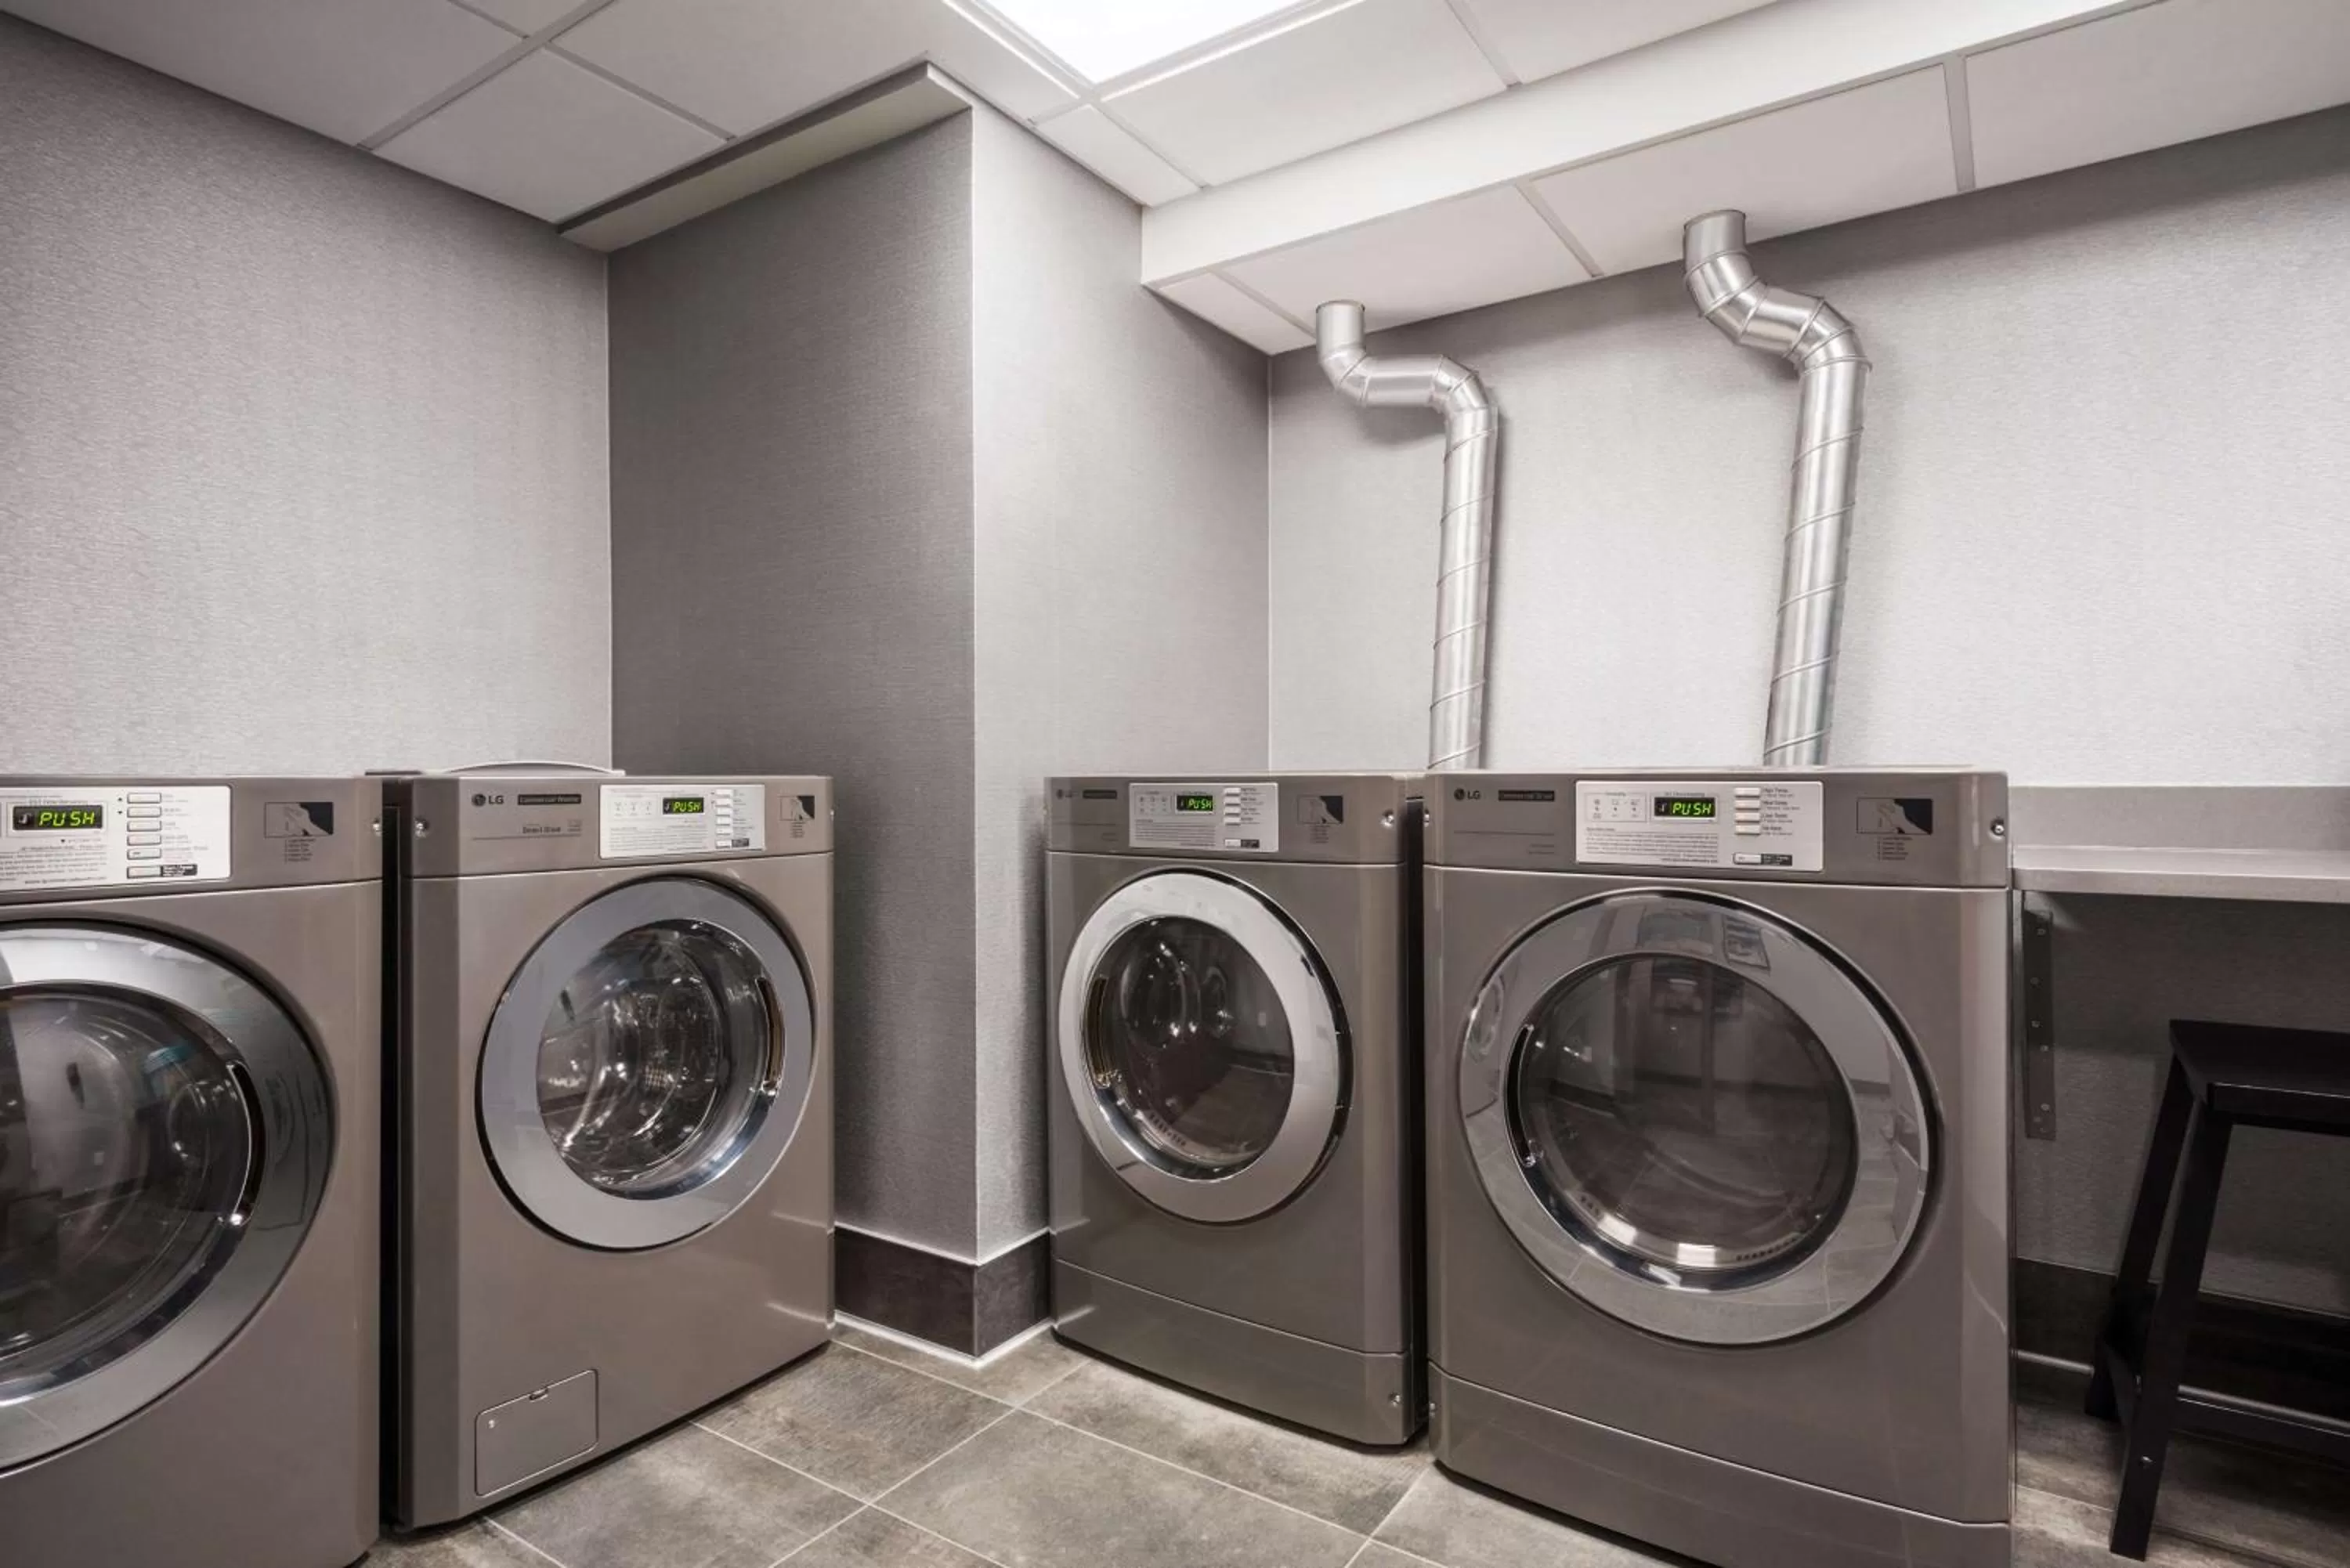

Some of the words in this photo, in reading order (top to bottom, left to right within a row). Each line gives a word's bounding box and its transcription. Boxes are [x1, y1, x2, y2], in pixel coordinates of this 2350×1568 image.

[673, 800, 702, 813] PUSH
[1188, 797, 1213, 809] PUSH
[1672, 802, 1712, 816] PUSH
[38, 811, 96, 827] PUSH
